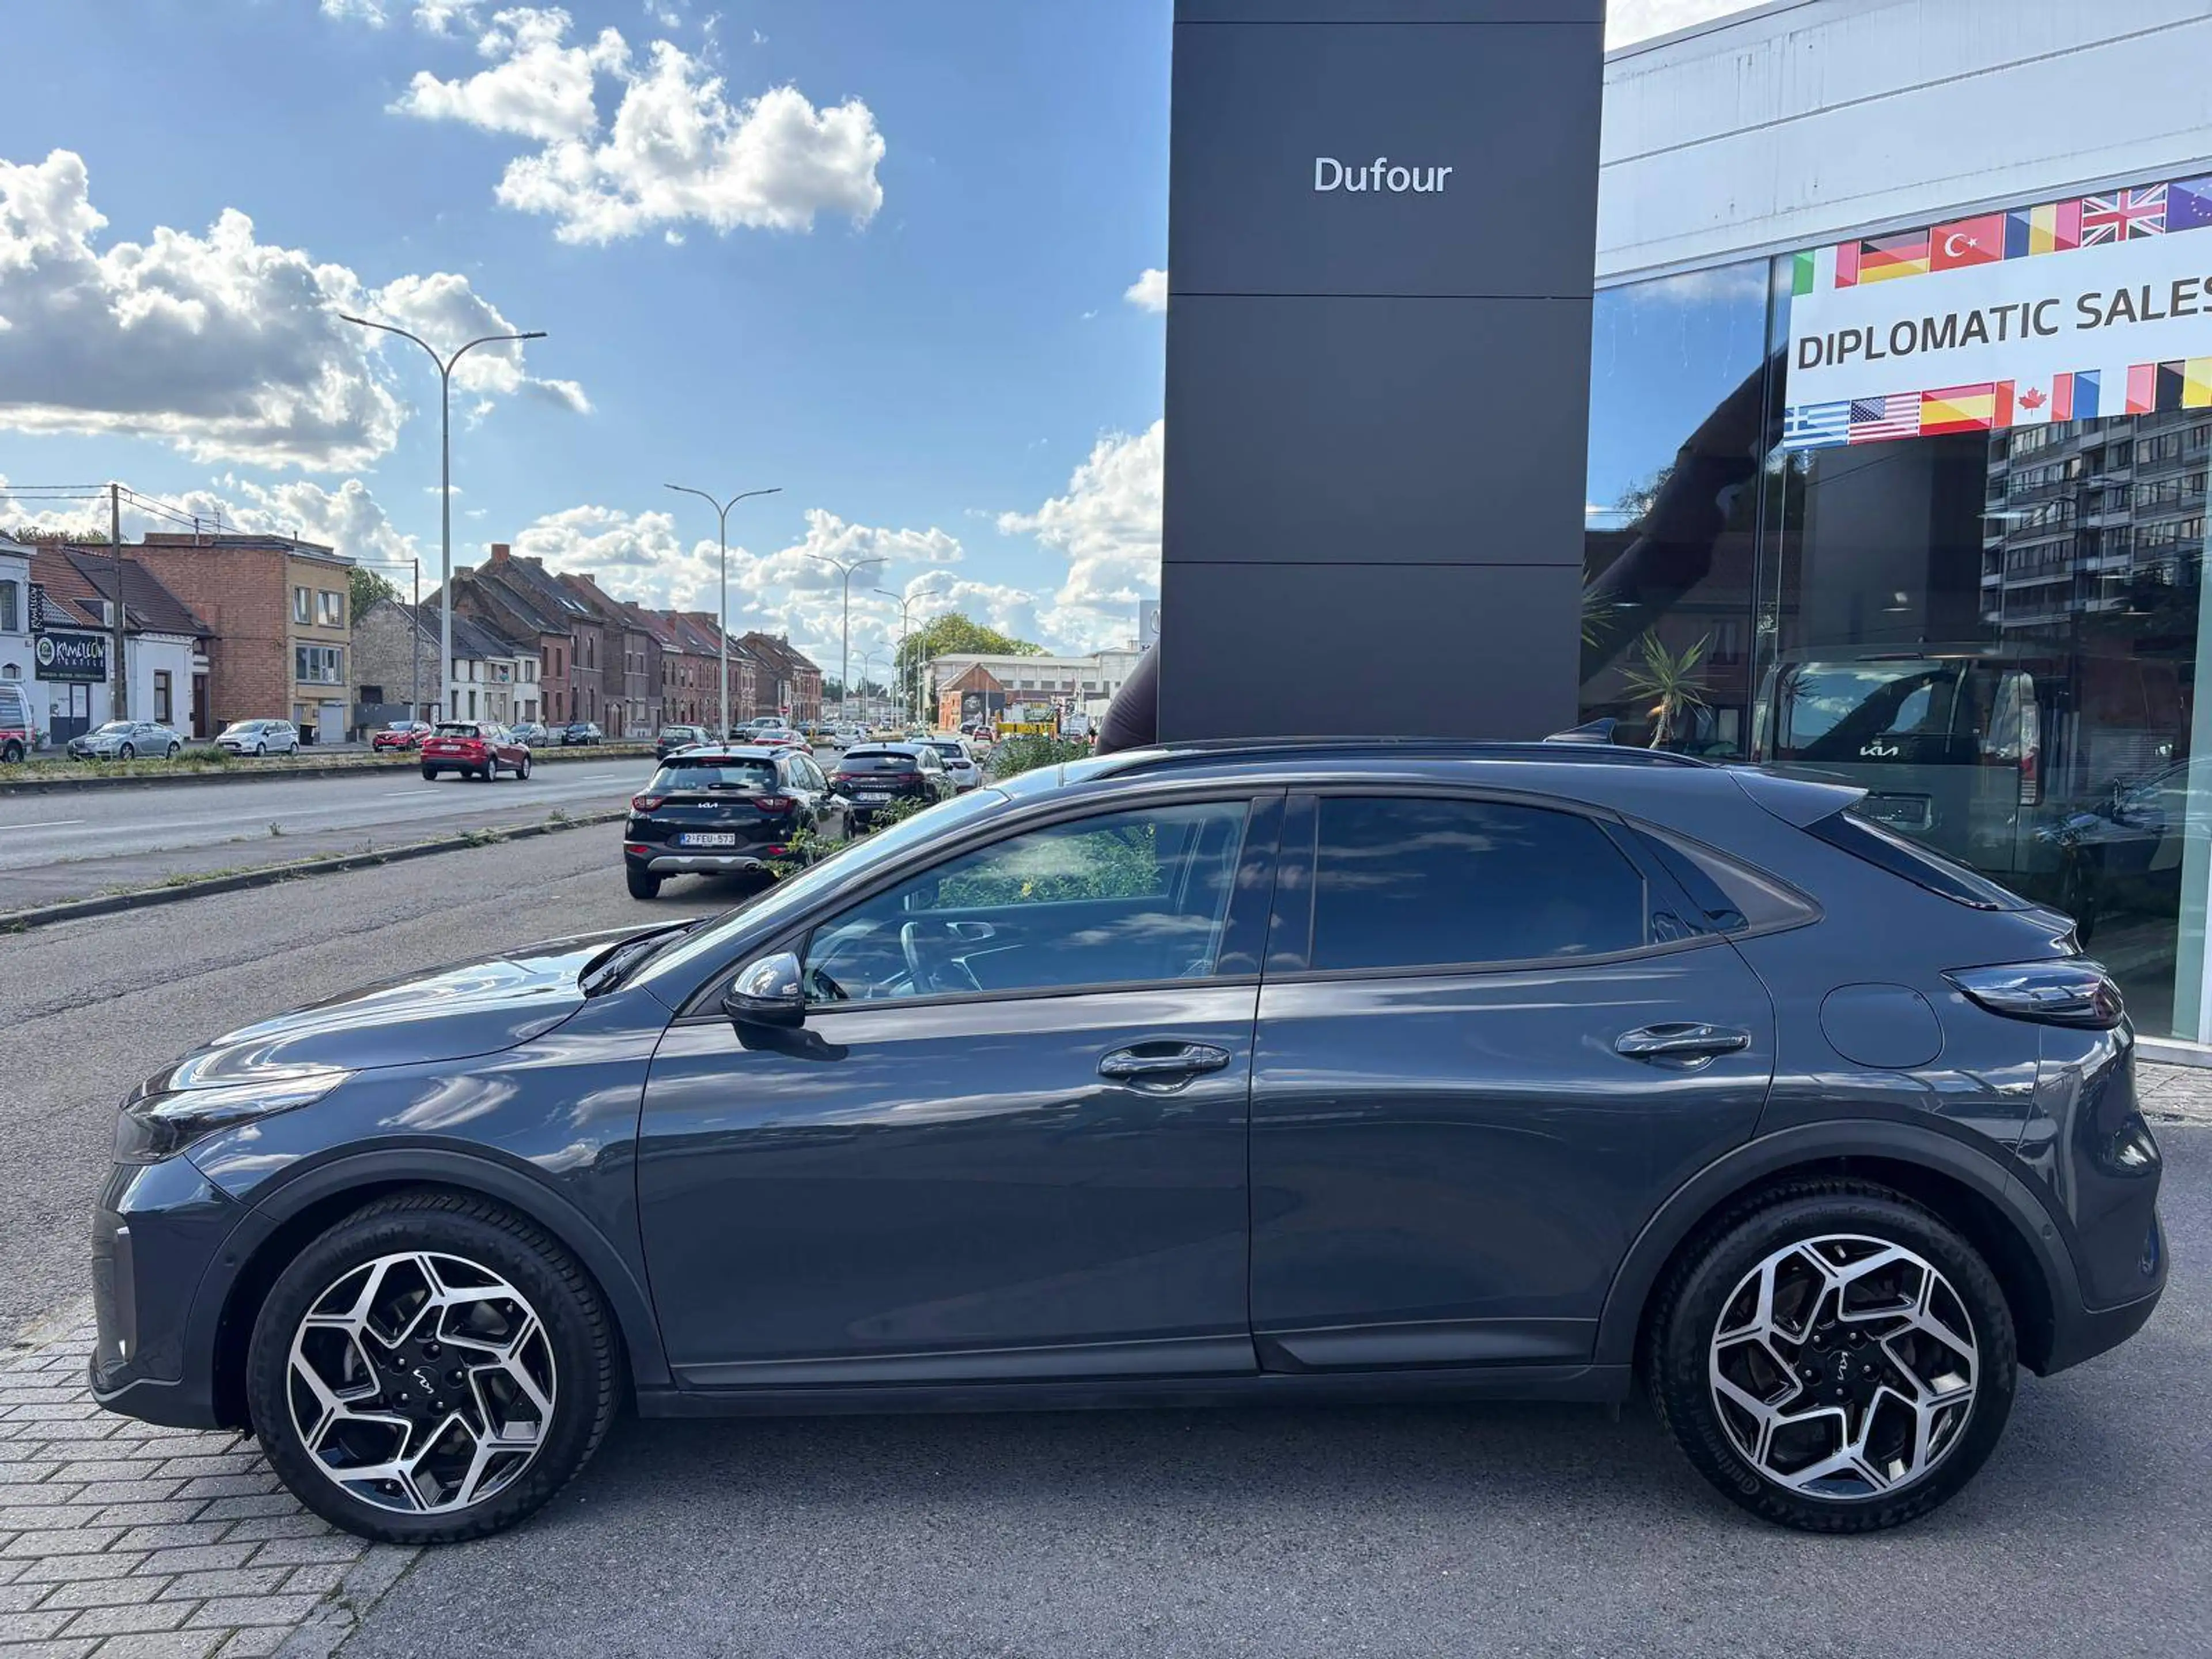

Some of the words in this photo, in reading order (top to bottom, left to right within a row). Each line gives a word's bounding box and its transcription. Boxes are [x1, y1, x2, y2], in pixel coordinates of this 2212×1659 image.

[1314, 157, 1453, 192] Dufour
[1798, 298, 2060, 370] DIPLOMATIC
[1860, 746, 1899, 756] KIA
